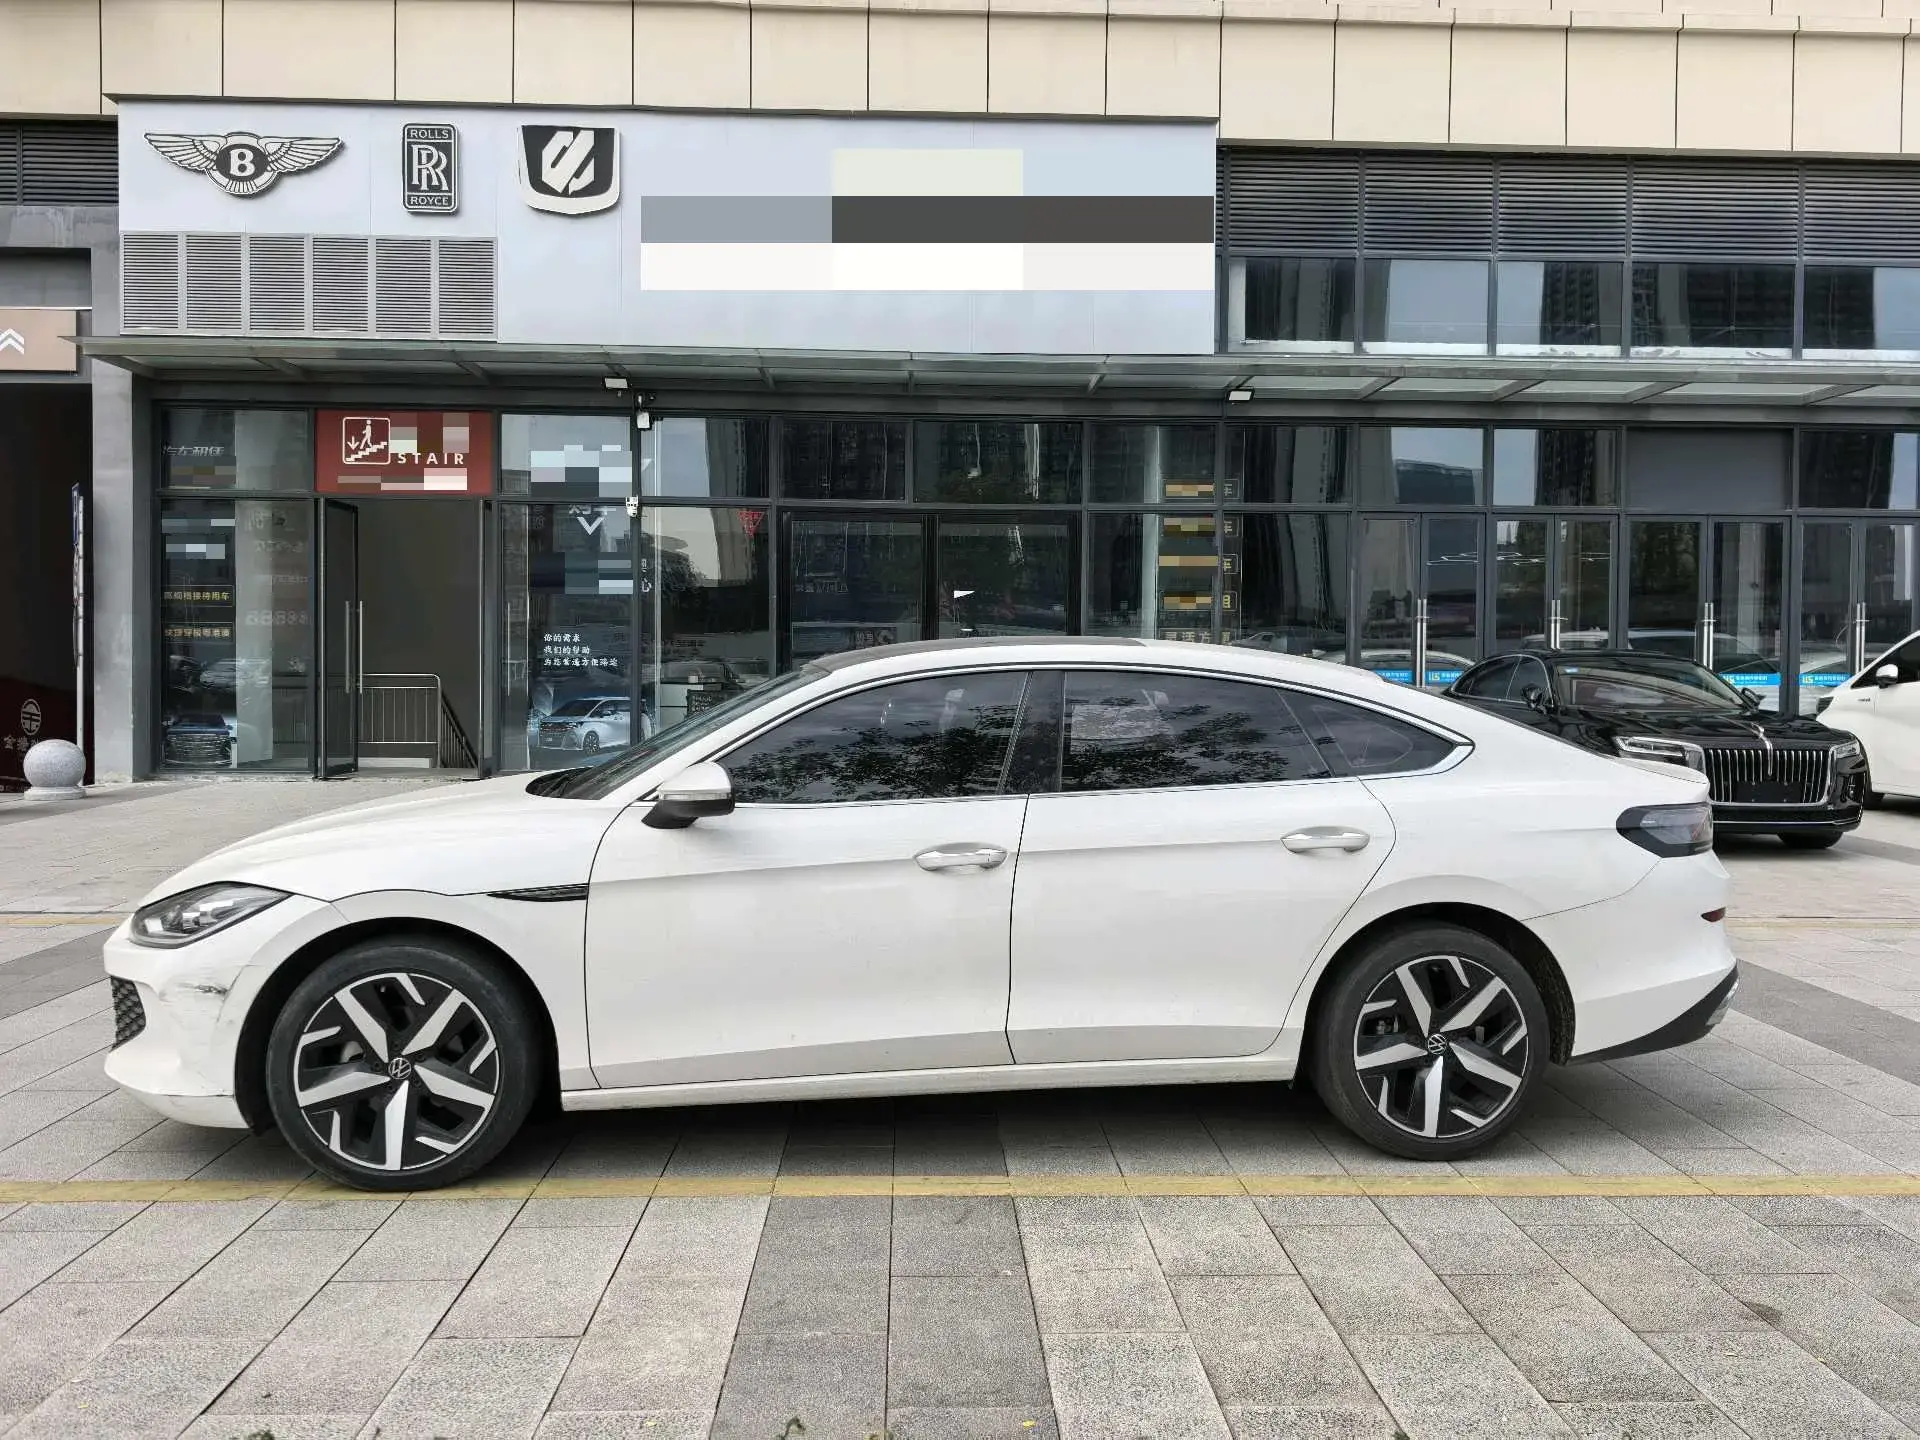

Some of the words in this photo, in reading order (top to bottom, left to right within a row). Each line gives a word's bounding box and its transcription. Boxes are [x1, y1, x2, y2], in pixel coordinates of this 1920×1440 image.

[410, 129, 449, 139] ROLLS
[229, 148, 256, 177] B
[410, 196, 449, 206] ROYCE
[397, 452, 464, 465] STAIR
